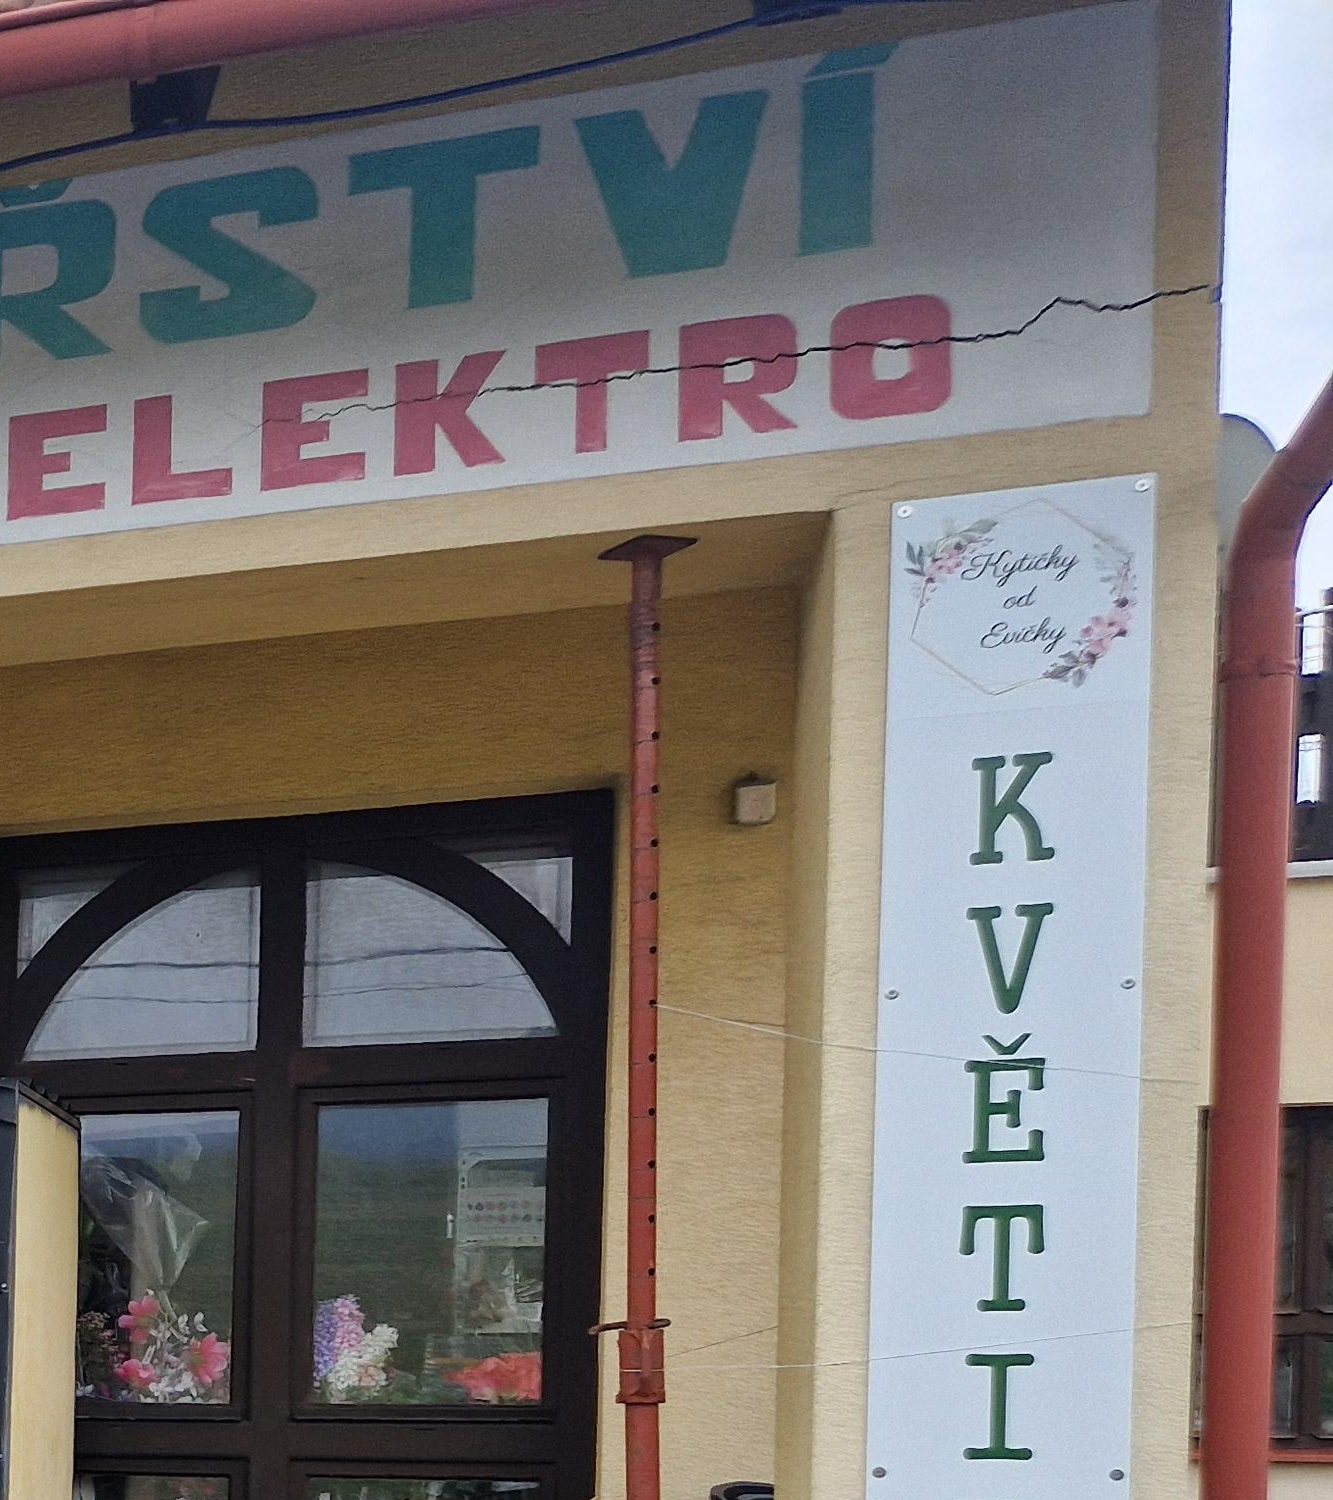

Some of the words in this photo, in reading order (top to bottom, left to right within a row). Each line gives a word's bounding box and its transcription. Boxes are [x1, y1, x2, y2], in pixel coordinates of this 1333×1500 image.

[960, 544, 1079, 588] Kytičky
[1002, 586, 1037, 609] od
[979, 617, 1067, 654] Evičky
